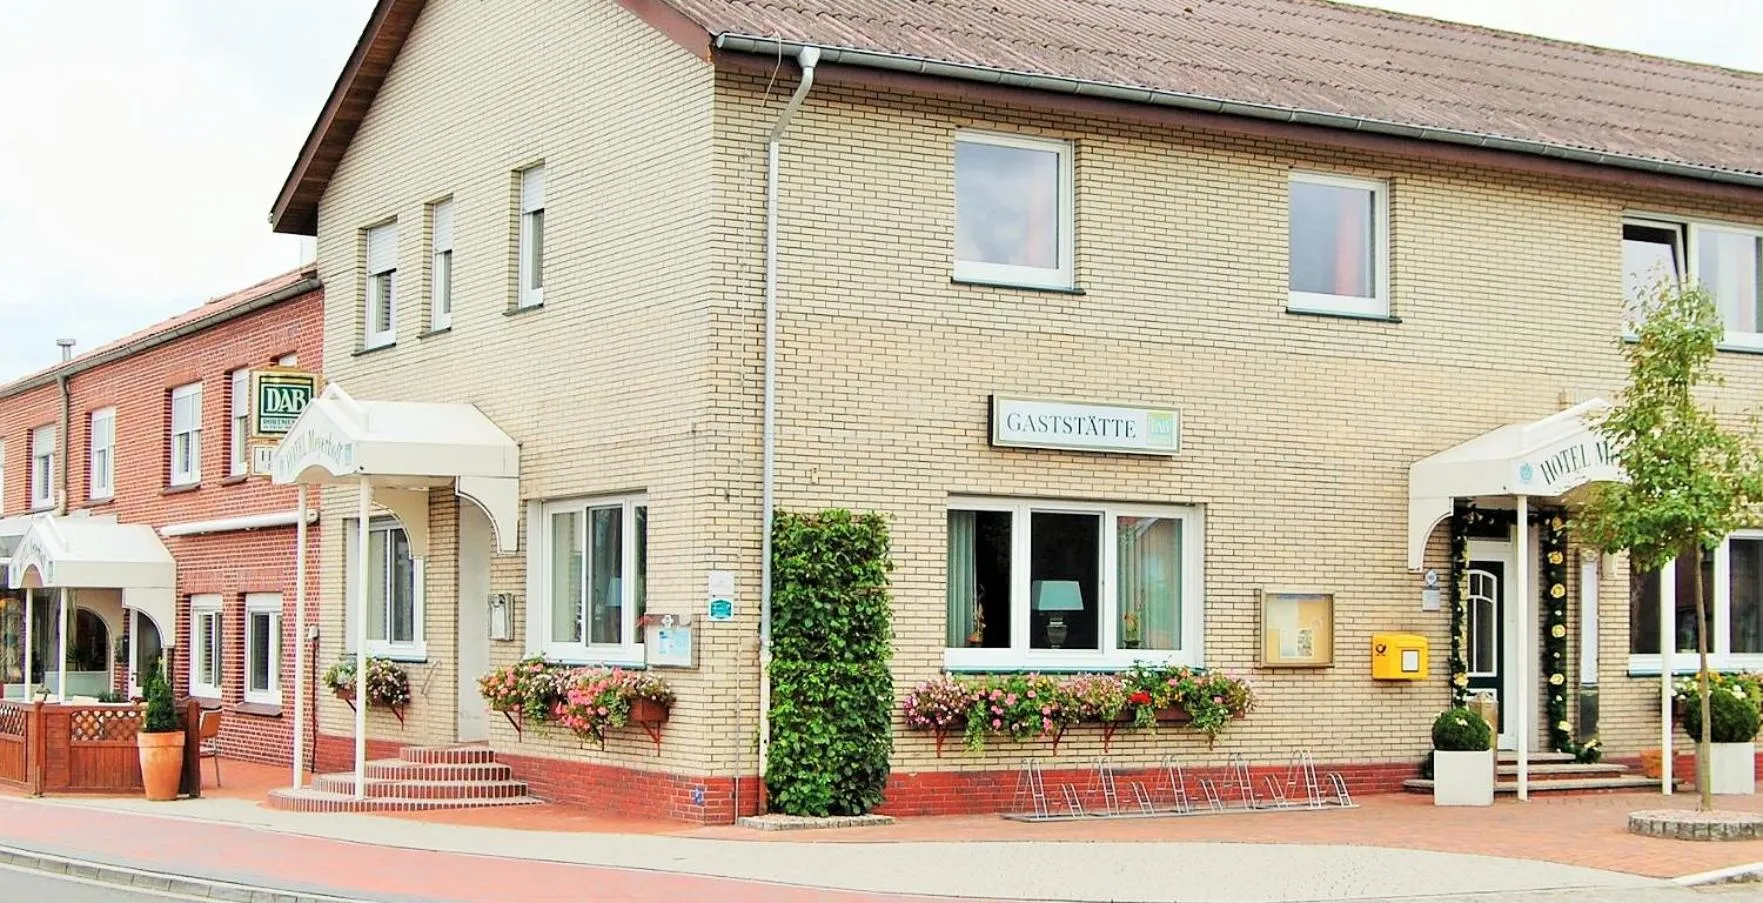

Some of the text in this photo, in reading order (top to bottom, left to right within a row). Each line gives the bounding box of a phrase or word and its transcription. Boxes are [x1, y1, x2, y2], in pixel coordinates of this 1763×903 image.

[266, 387, 306, 413] DAB
[1007, 411, 1137, 439] GASTSTÄTTE
[1540, 443, 1591, 485] HOTEL
